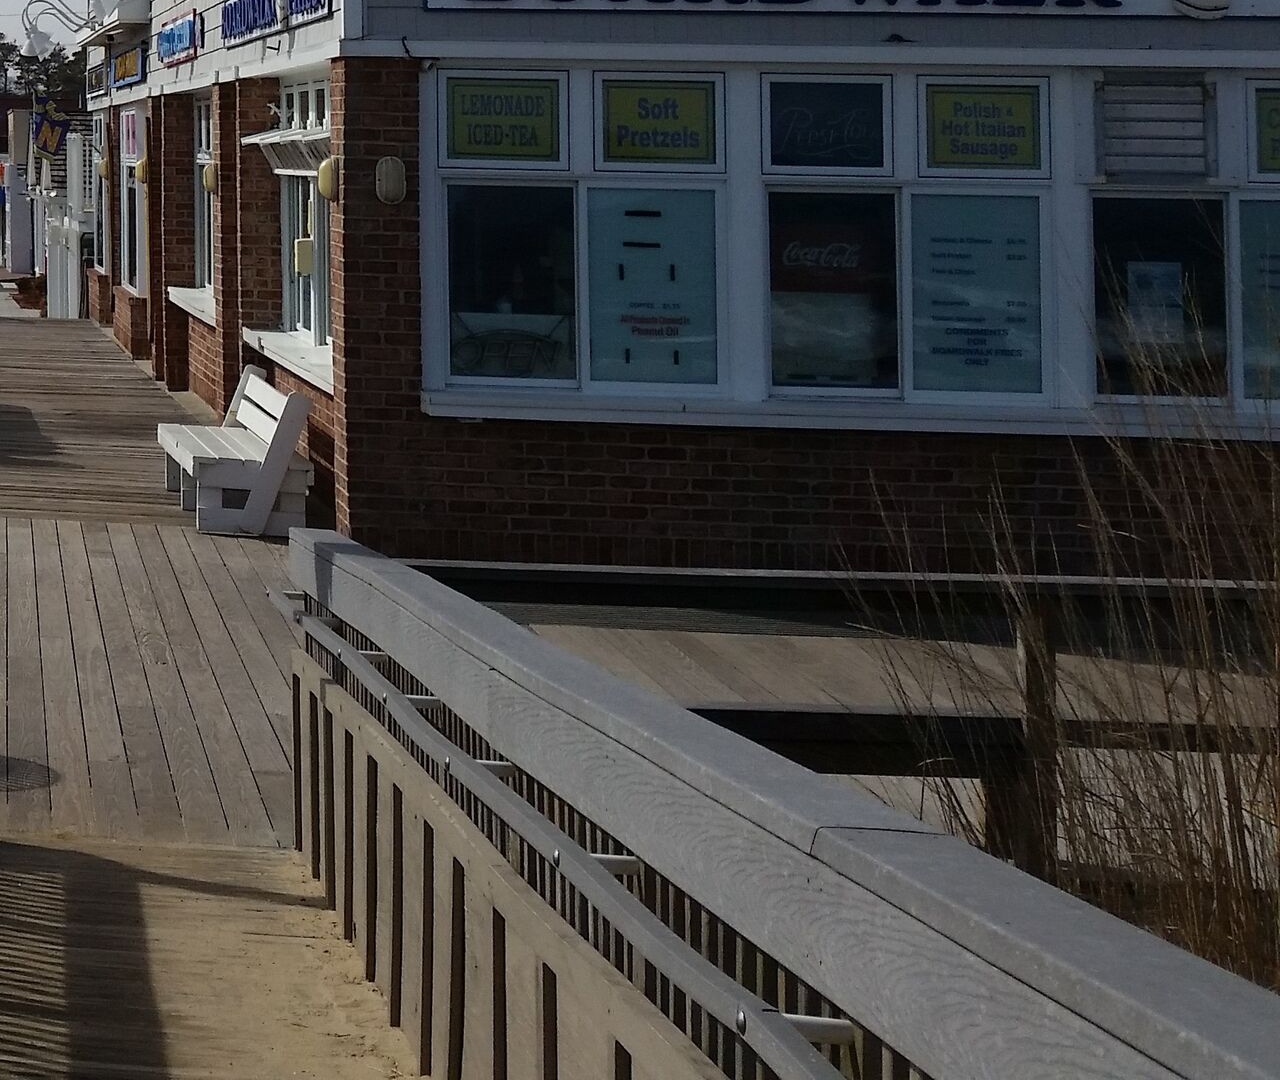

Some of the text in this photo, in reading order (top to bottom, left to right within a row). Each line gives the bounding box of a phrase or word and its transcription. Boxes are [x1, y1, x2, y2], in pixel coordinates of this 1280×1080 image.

[460, 94, 545, 117] LEMONADE
[637, 97, 679, 120] Soft
[953, 102, 1001, 118] Polish
[616, 124, 700, 148] Pretzels
[942, 120, 1026, 137] Hot Italian
[950, 138, 1018, 160] Sausage
